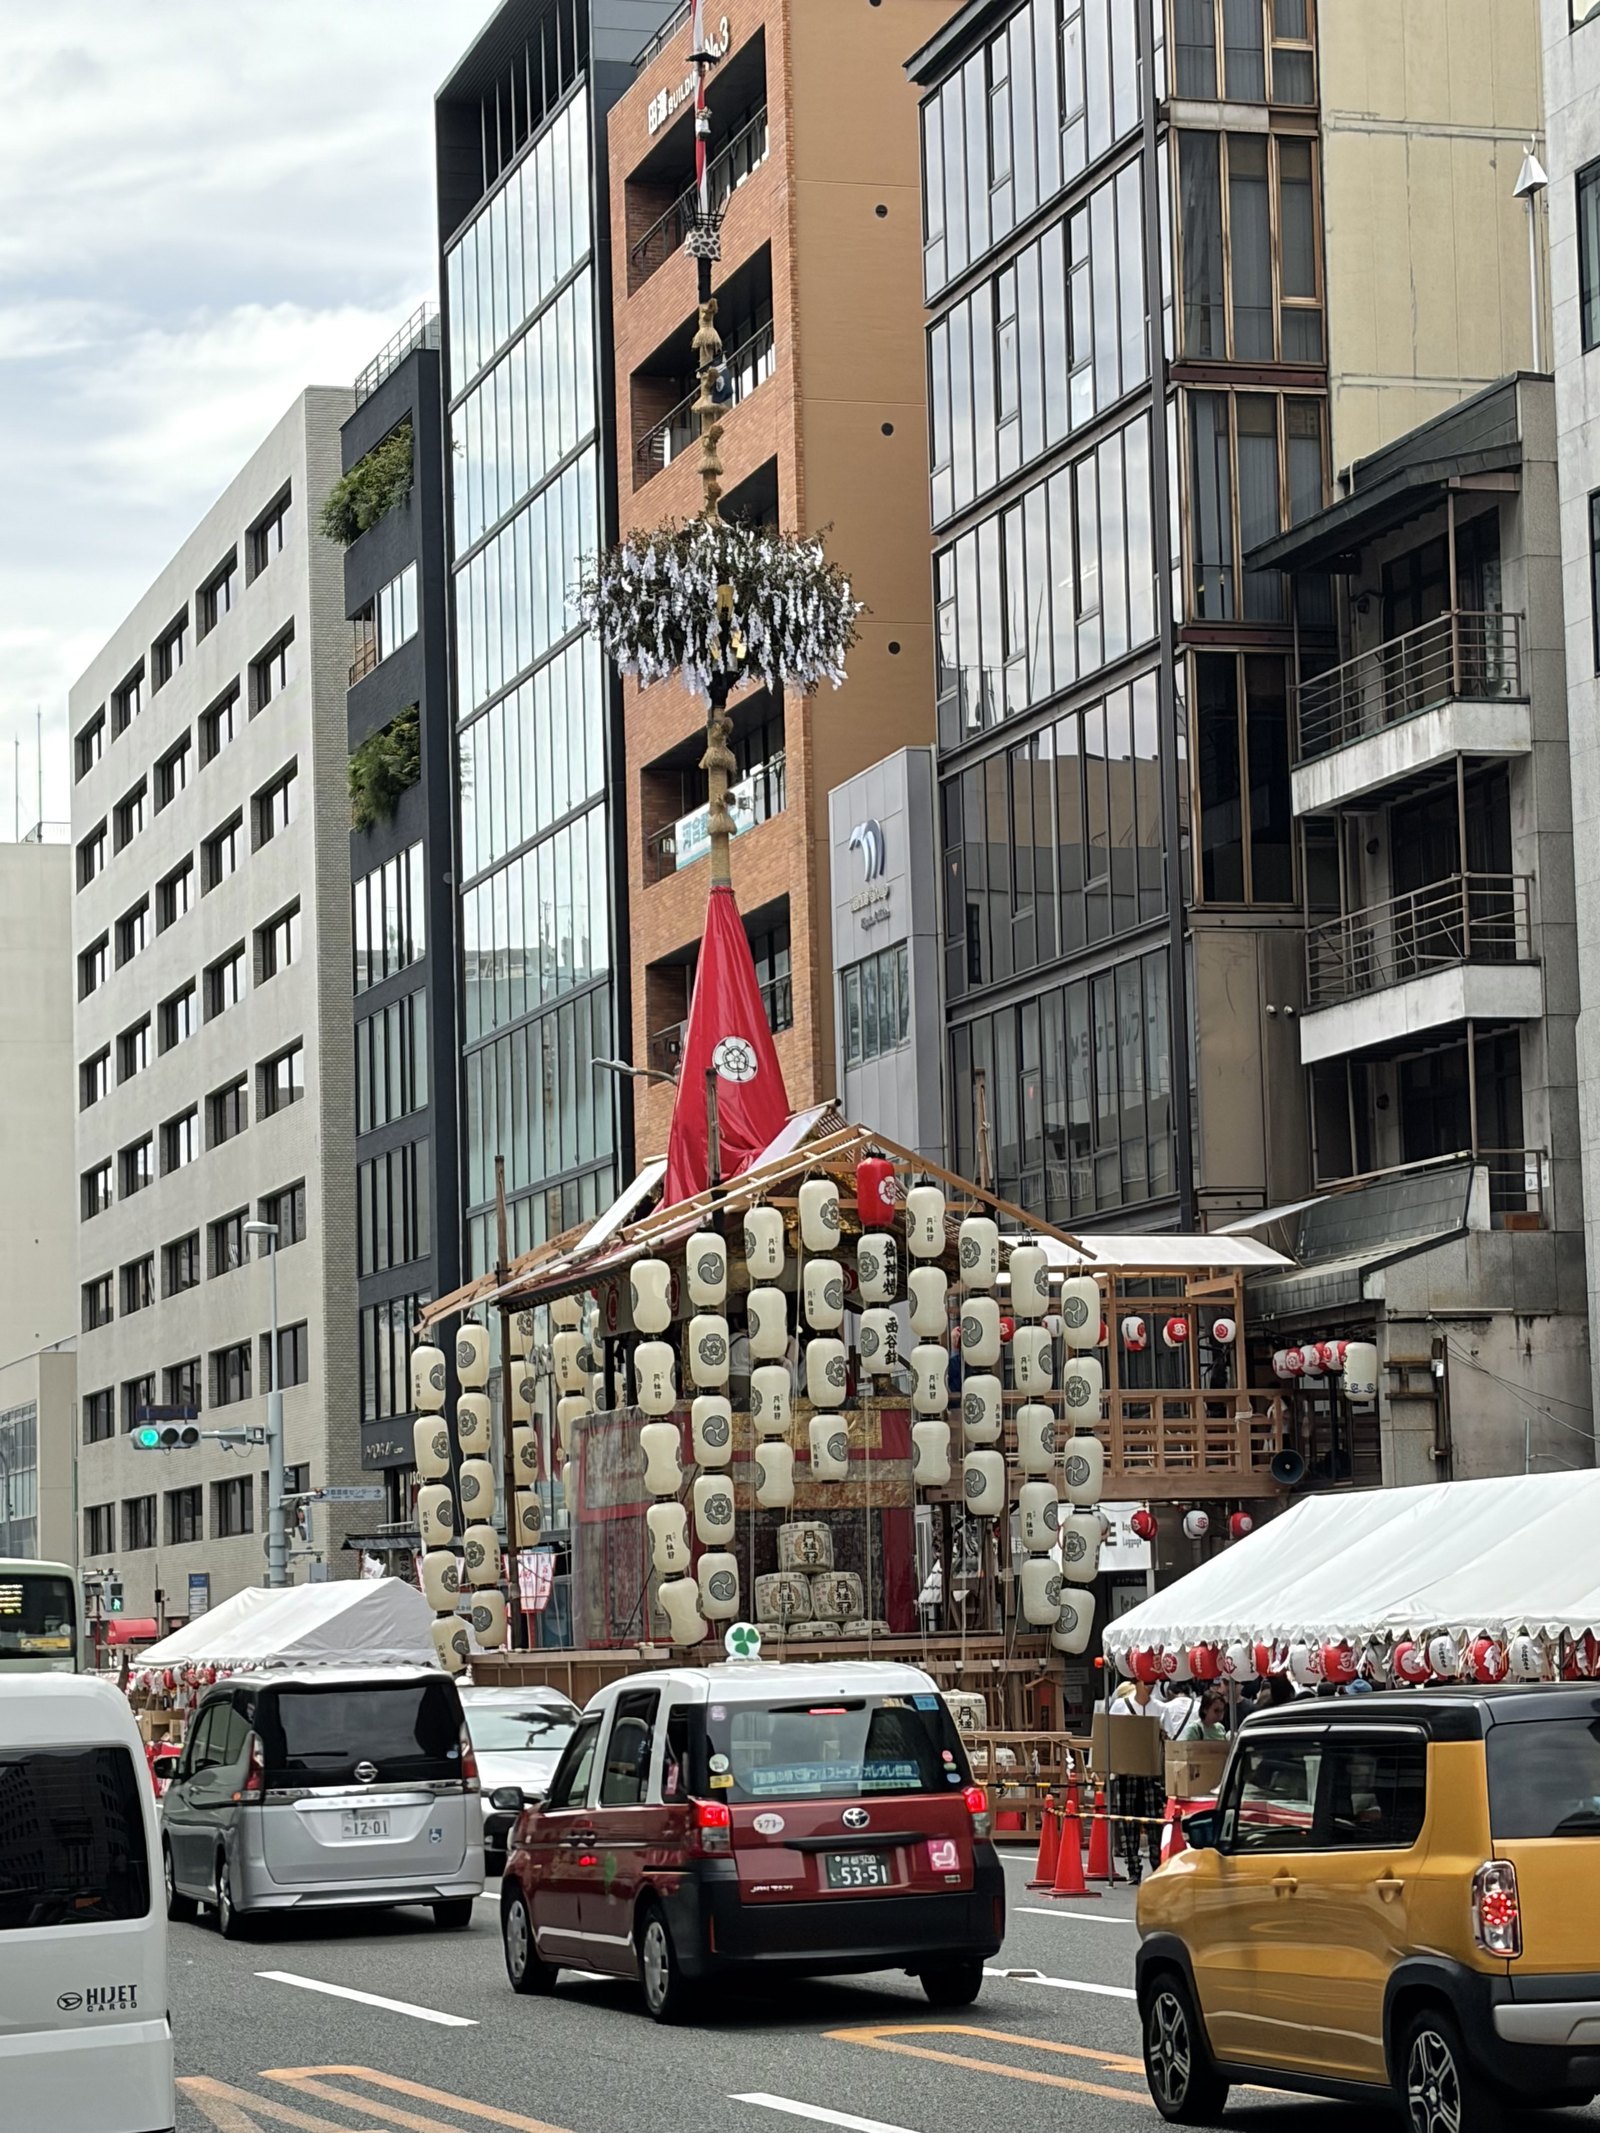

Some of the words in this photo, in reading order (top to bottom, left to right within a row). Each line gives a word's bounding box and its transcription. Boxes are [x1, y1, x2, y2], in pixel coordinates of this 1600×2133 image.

[882, 1240, 896, 1296] 御神燈
[884, 1316, 898, 1366] 函谷鉾
[802, 1530, 819, 1564] 月桂冠
[777, 1581, 795, 1615] 月桂冠
[836, 1580, 853, 1614] 月桂冠
[86, 1984, 138, 2006] HIJET
[86, 2001, 138, 2013] CARGO
